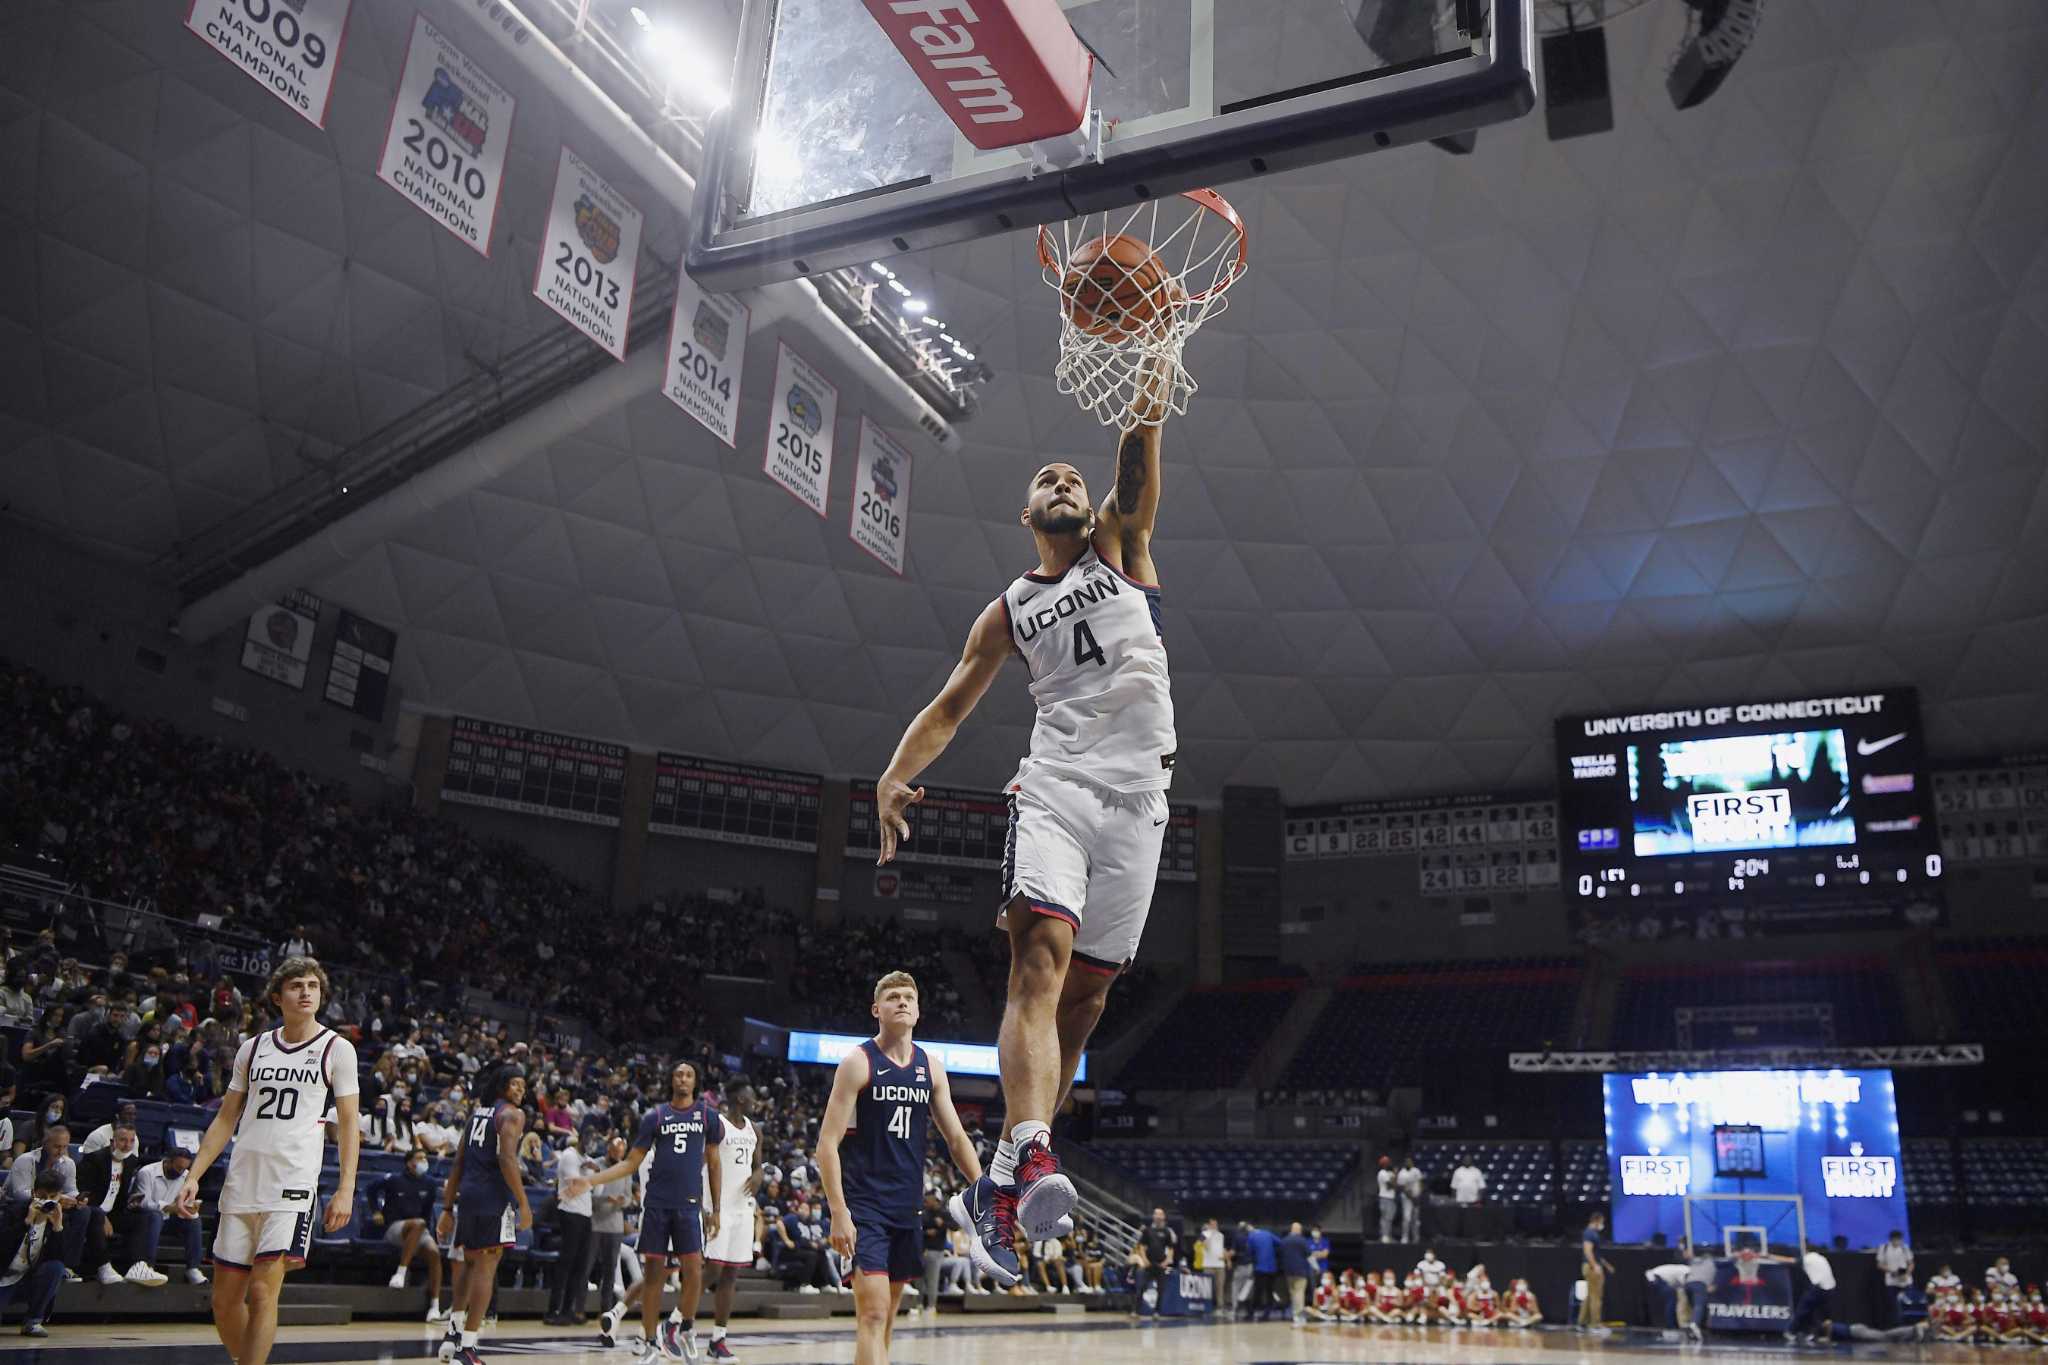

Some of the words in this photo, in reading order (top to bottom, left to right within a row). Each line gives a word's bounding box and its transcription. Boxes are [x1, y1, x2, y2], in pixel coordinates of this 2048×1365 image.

[219, 6, 307, 86] NATIONAL
[230, 0, 327, 69] 009
[206, 22, 310, 110] CHAMPIONS
[888, 0, 1024, 124] Farm
[403, 118, 486, 200] 2010
[393, 170, 477, 241] CHAMPIONS
[404, 155, 474, 220] NATIONAL
[555, 241, 620, 309] 2013
[547, 289, 615, 347] CHAMPIONS
[555, 274, 612, 328] NATIONAL
[679, 341, 731, 402] 2014
[673, 386, 728, 436] CHAMPIONS
[680, 372, 725, 417] NATIONAL
[777, 423, 822, 475] 2015
[772, 465, 820, 508] CHAMPIONS
[778, 452, 819, 491] NATIONAL
[861, 491, 900, 538] 2016
[857, 530, 898, 567] CHAMPIONS
[861, 519, 896, 552] NATIONAL
[1017, 574, 1119, 642] UCONN
[1073, 619, 1106, 666] 4
[1584, 710, 1701, 736] UNIVERSITY
[1704, 707, 1734, 725] OF
[1736, 695, 1884, 722] CONNECTICUT
[1693, 794, 1783, 818] FIRST
[1579, 875, 1593, 896] 0
[1925, 854, 1942, 877] 0
[241, 956, 271, 976] 109
[251, 1067, 319, 1085] UCONN
[872, 1086, 930, 1104] UCONN
[257, 1087, 299, 1120] 20
[888, 1106, 912, 1140] 41
[469, 1117, 489, 1147] 14
[661, 1122, 704, 1135] UCONN
[673, 1133, 688, 1154] 5
[735, 1147, 749, 1165] 21
[1625, 1160, 1684, 1175] FIRST
[1827, 1161, 1890, 1176] FIRST
[1707, 1303, 1791, 1320] TRAVELERS
